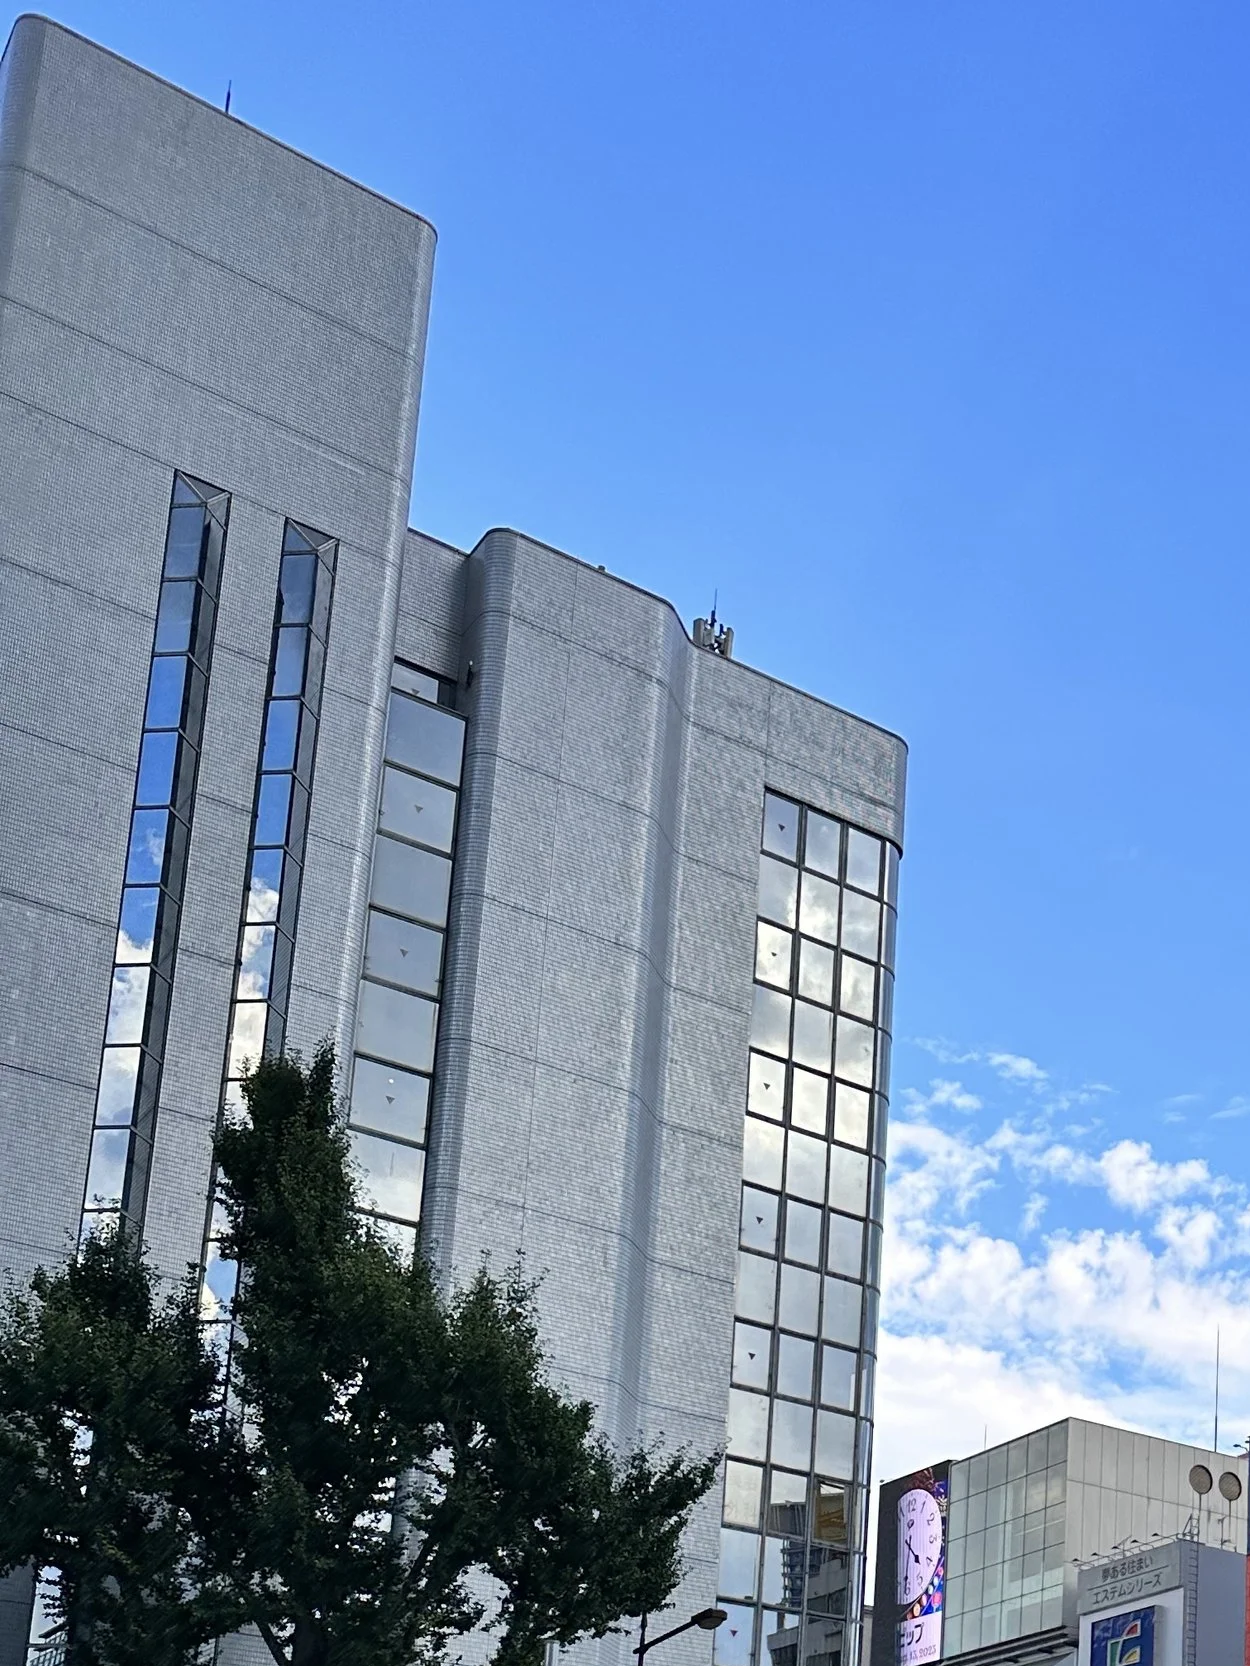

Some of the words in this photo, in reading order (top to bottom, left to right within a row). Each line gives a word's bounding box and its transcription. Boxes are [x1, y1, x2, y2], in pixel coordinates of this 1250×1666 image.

[1092, 1572, 1163, 1605] エステムシリーズ
